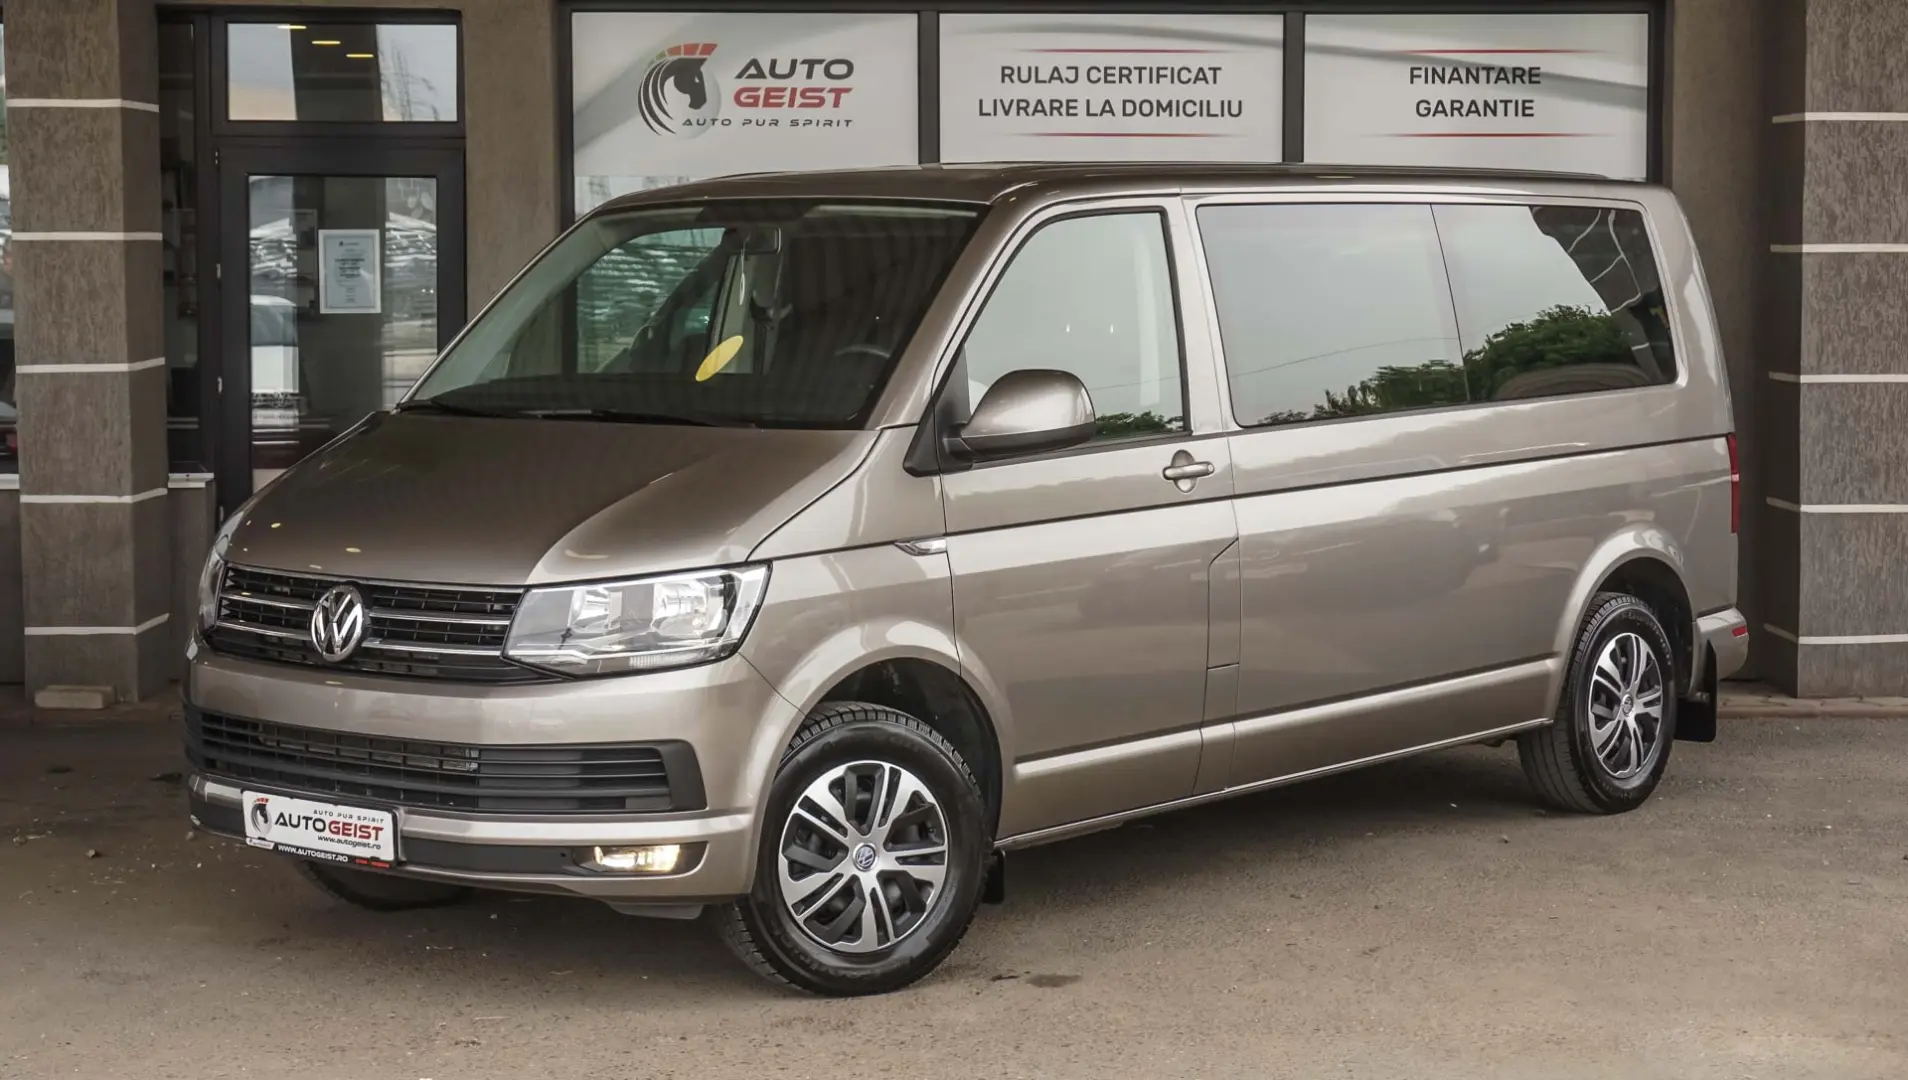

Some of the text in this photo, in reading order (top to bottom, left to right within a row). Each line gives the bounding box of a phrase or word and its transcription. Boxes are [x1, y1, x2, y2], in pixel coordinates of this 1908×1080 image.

[734, 58, 855, 80] AUTO
[1001, 65, 1223, 86] RULAJ CERTIFICAT
[1409, 66, 1542, 85] FINANTARE
[733, 86, 854, 109] GEIST
[978, 98, 1243, 118] LIVRARE LA DOMICILIU
[1415, 99, 1535, 118] GARANTIE
[682, 118, 853, 128] AUTO PUR SPIRIT
[313, 809, 334, 817] AUTO
[357, 815, 385, 824] SPIRIT
[318, 835, 381, 850] www.autogeist.ro
[277, 844, 349, 863] WWW.AUTOGEIST.RO
